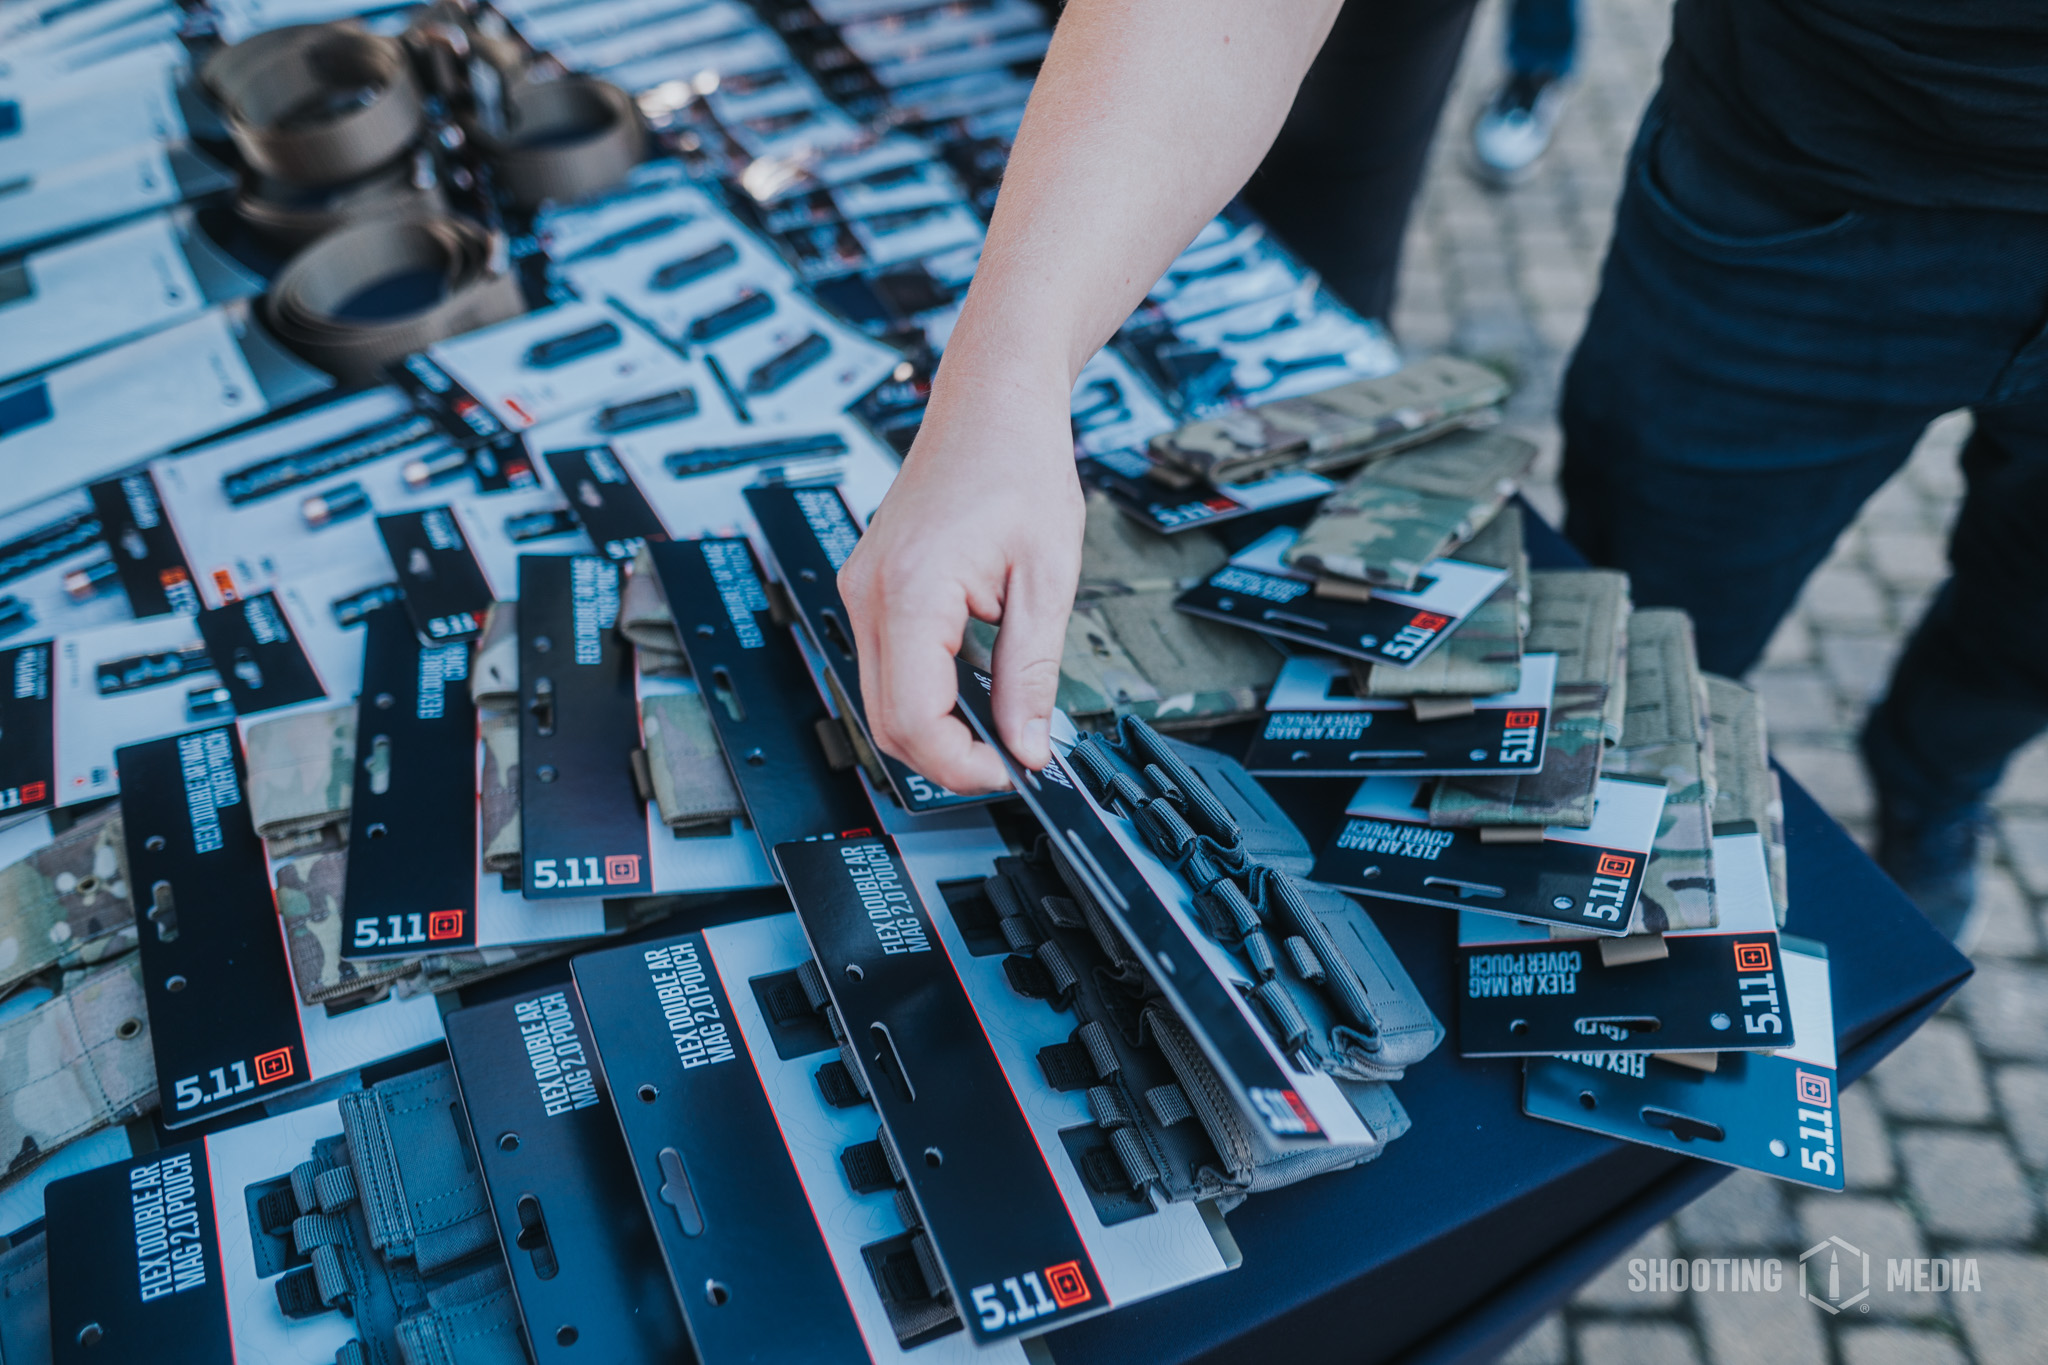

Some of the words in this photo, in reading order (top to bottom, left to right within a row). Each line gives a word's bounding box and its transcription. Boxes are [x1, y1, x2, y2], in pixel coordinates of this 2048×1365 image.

[1381, 625, 1436, 660] 5.11
[1499, 726, 1538, 763] 5.11
[193, 821, 224, 853] FLEX
[1336, 833, 1379, 852] MAG
[1343, 819, 1402, 842] POUCH
[1376, 839, 1402, 855] AR
[1400, 826, 1455, 848] COVER
[841, 845, 869, 865] AR
[863, 844, 903, 890] POUCH
[1400, 842, 1442, 861] FLEX
[534, 857, 604, 889] 5.11
[848, 867, 893, 920] DOUBLE
[884, 890, 915, 915] 2.0
[1583, 876, 1630, 922] 5.11
[353, 912, 426, 948] 5.11
[873, 920, 908, 955] FLEX
[896, 917, 932, 953] MAG
[644, 947, 674, 970] AR
[669, 942, 710, 995] POUCH
[1469, 954, 1526, 977] POUCH
[1526, 951, 1582, 974] COVER
[652, 970, 696, 1031] DOUBLE
[1469, 976, 1510, 998] MAG
[1511, 974, 1535, 996] AR
[1536, 972, 1577, 995] FLEX
[514, 998, 544, 1023] AR
[540, 992, 578, 1045] POUCH
[688, 994, 720, 1022] 2.0
[1739, 972, 1783, 1034] 5.11
[520, 1021, 562, 1080] DOUBLE
[556, 1041, 587, 1070] 2.0
[673, 1028, 710, 1069] FLEX
[699, 1022, 736, 1064] MAG
[1606, 1052, 1645, 1079] FLEX
[174, 1060, 255, 1111] 5.11
[538, 1076, 573, 1117] FLEX
[564, 1069, 600, 1110] MAG
[1798, 1108, 1836, 1176] 5.11
[130, 1162, 162, 1190] AR
[161, 1152, 196, 1215] POUCH
[132, 1187, 169, 1258] DOUBLE
[167, 1210, 201, 1245] 2.0
[139, 1252, 174, 1302] FLEX
[171, 1242, 206, 1293] MAG
[969, 1270, 1057, 1332] 5.11
